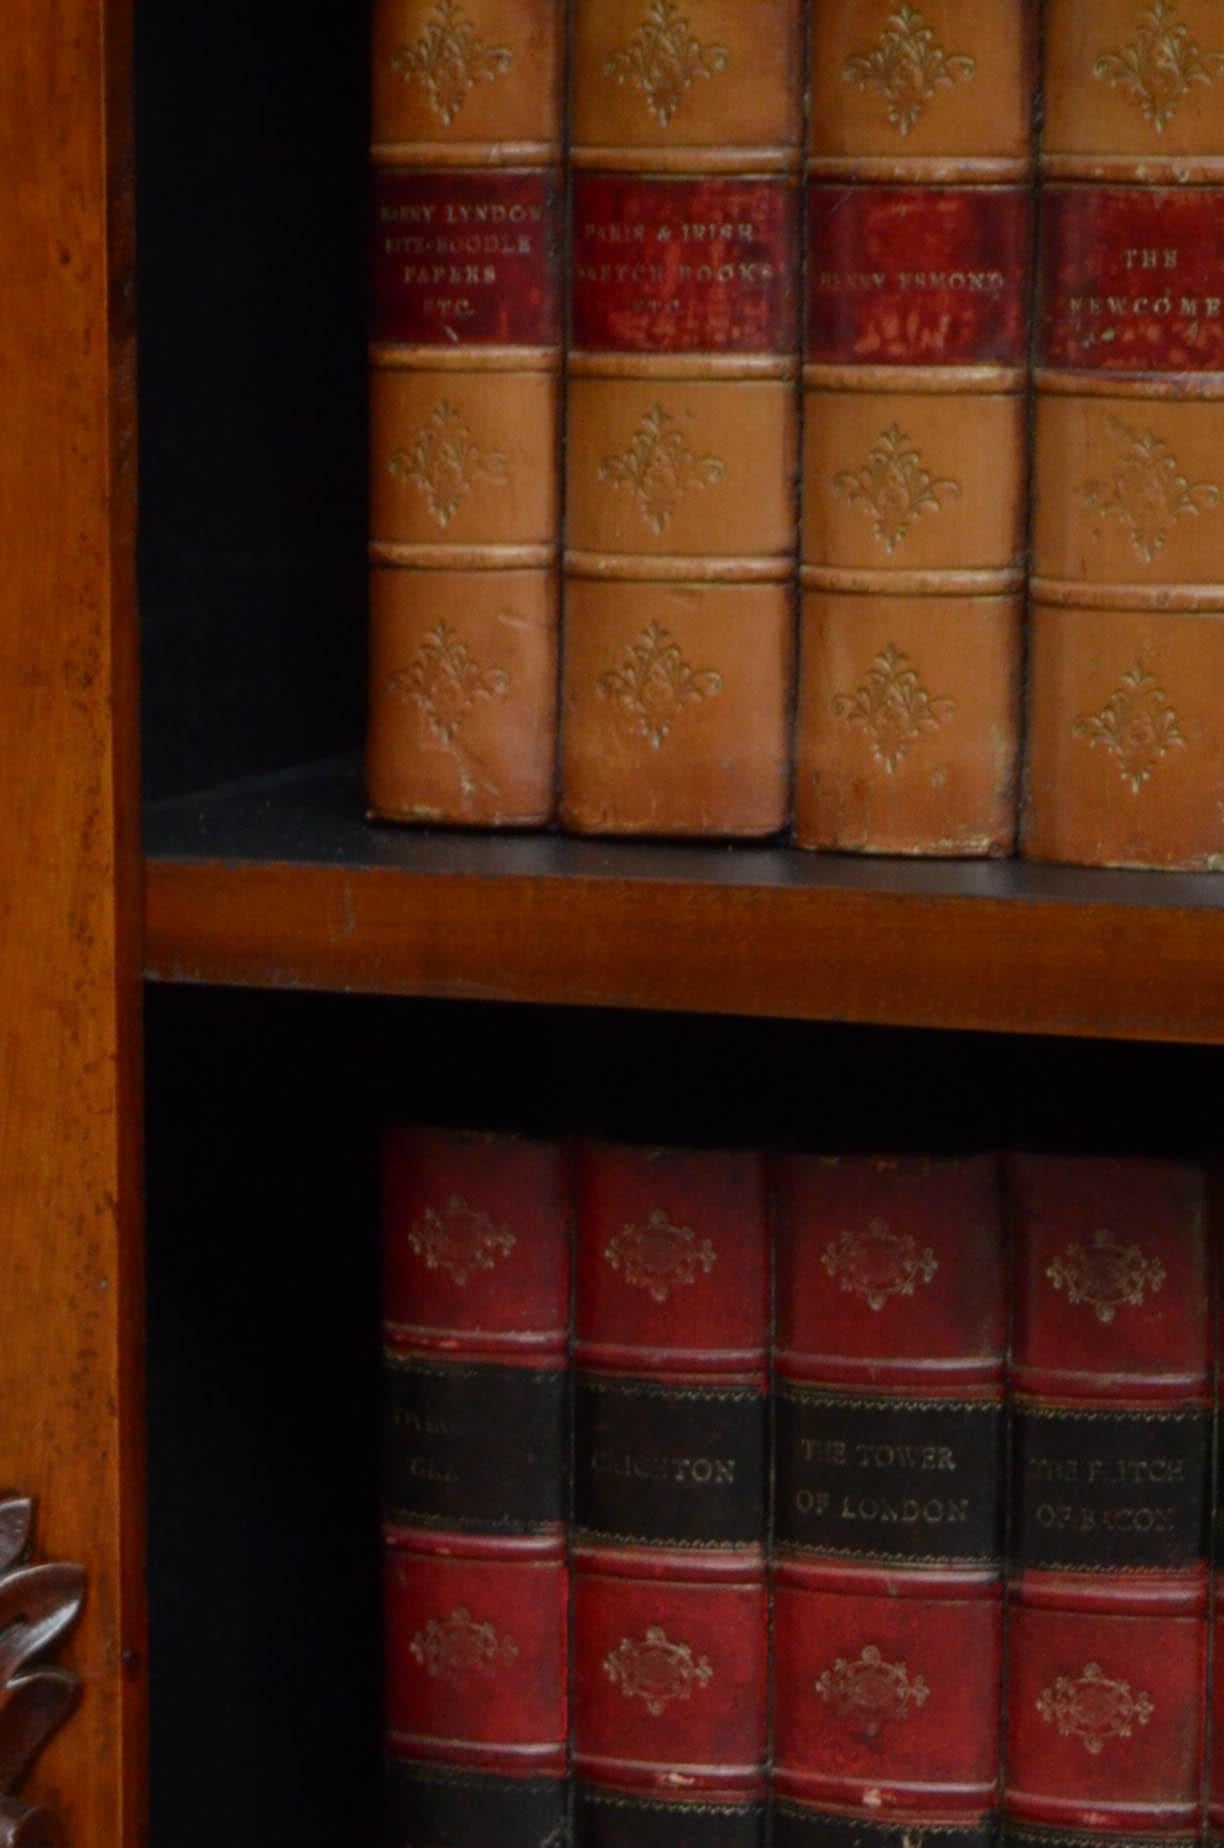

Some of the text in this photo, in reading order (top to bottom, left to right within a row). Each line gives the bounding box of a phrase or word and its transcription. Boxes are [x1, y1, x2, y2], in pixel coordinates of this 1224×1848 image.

[656, 225, 673, 243] &
[681, 222, 753, 243] IRISH
[1124, 248, 1179, 269] THE
[404, 265, 497, 285] PAPERS
[898, 271, 1005, 293] ESMOND
[800, 1438, 957, 1473] THE TOWER
[795, 1489, 969, 1524] OF LONDON
